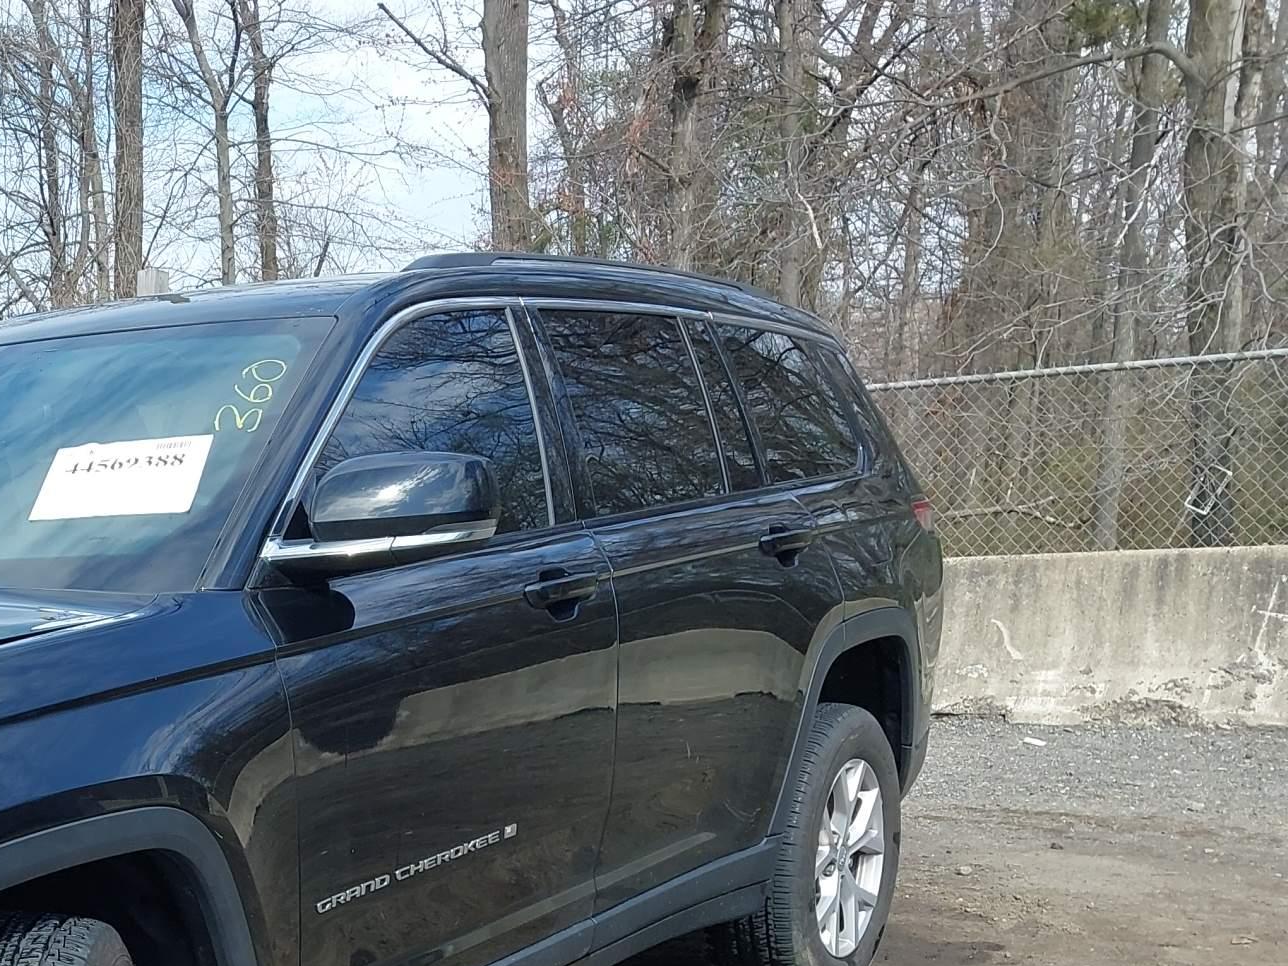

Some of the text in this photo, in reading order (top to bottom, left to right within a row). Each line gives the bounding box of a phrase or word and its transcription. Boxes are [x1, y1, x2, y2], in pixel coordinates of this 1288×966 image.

[214, 359, 287, 432] 360
[65, 453, 186, 474] 44569388
[316, 830, 500, 914] GRAND CHEROKEE
